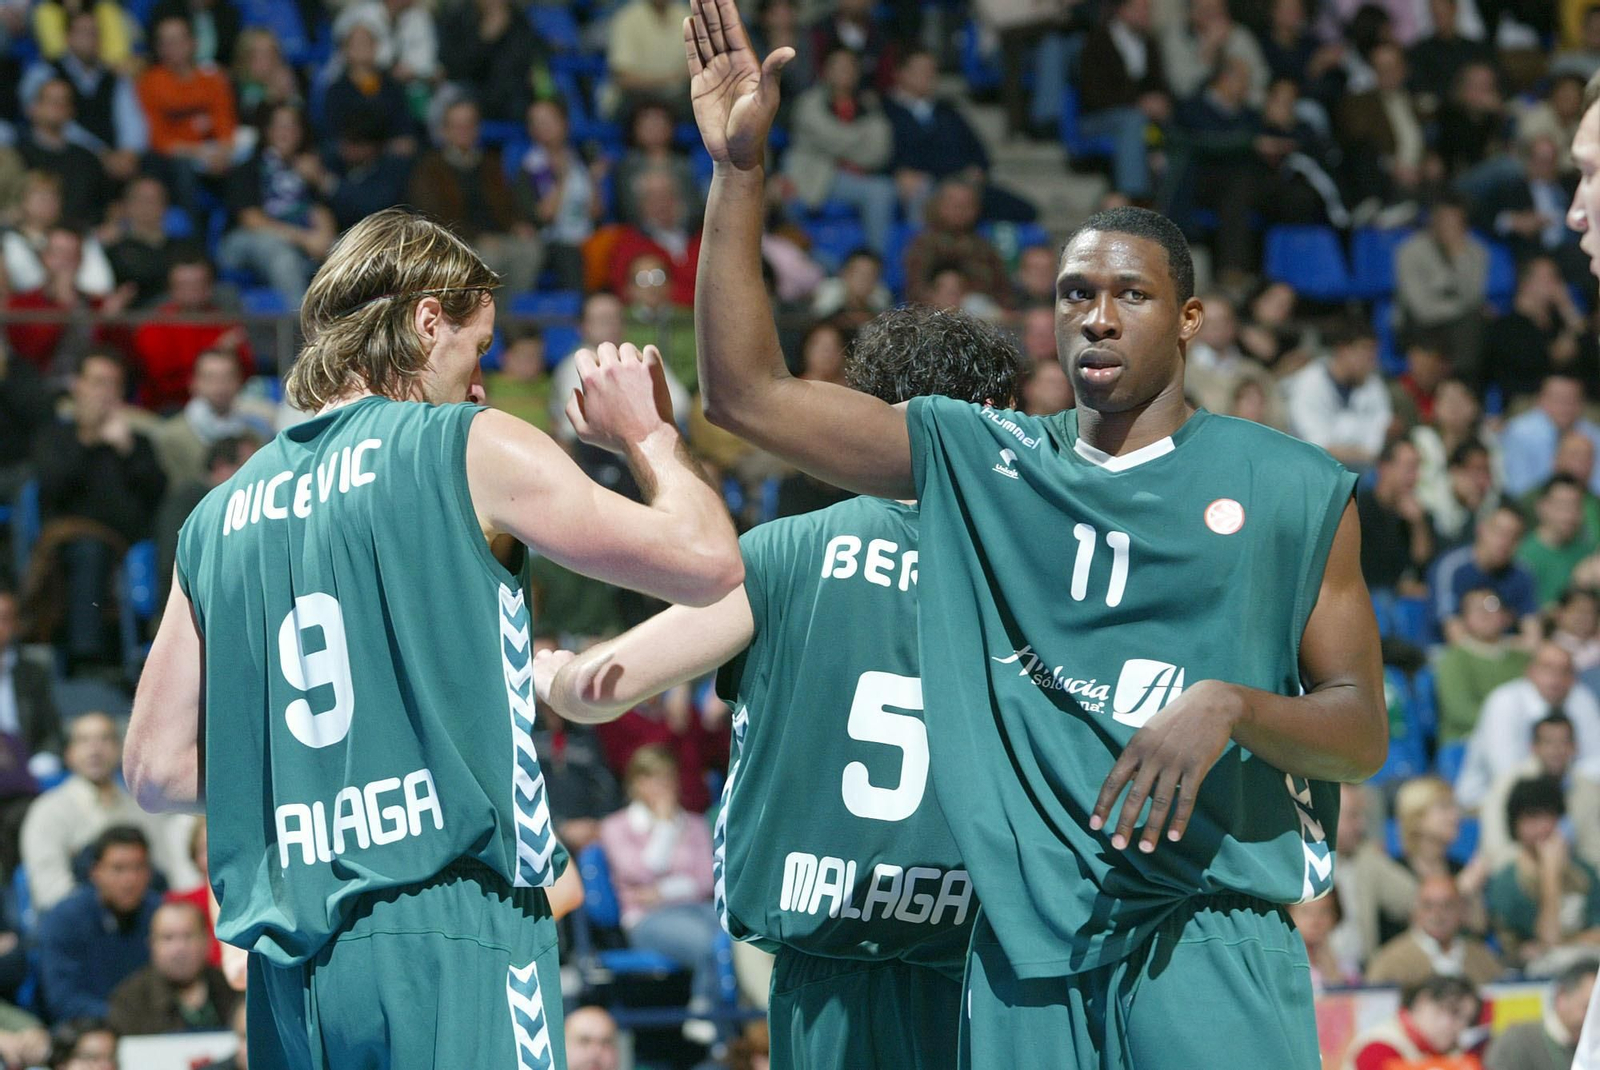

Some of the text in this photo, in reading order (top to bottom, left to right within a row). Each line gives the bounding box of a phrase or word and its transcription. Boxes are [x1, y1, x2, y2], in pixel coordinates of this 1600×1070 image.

[981, 406, 1042, 450] hummel
[222, 438, 383, 537] NICEVIC
[1070, 522, 1131, 608] 11
[278, 591, 355, 749] 9
[841, 670, 930, 822] 5
[778, 851, 974, 926] MALAGA
